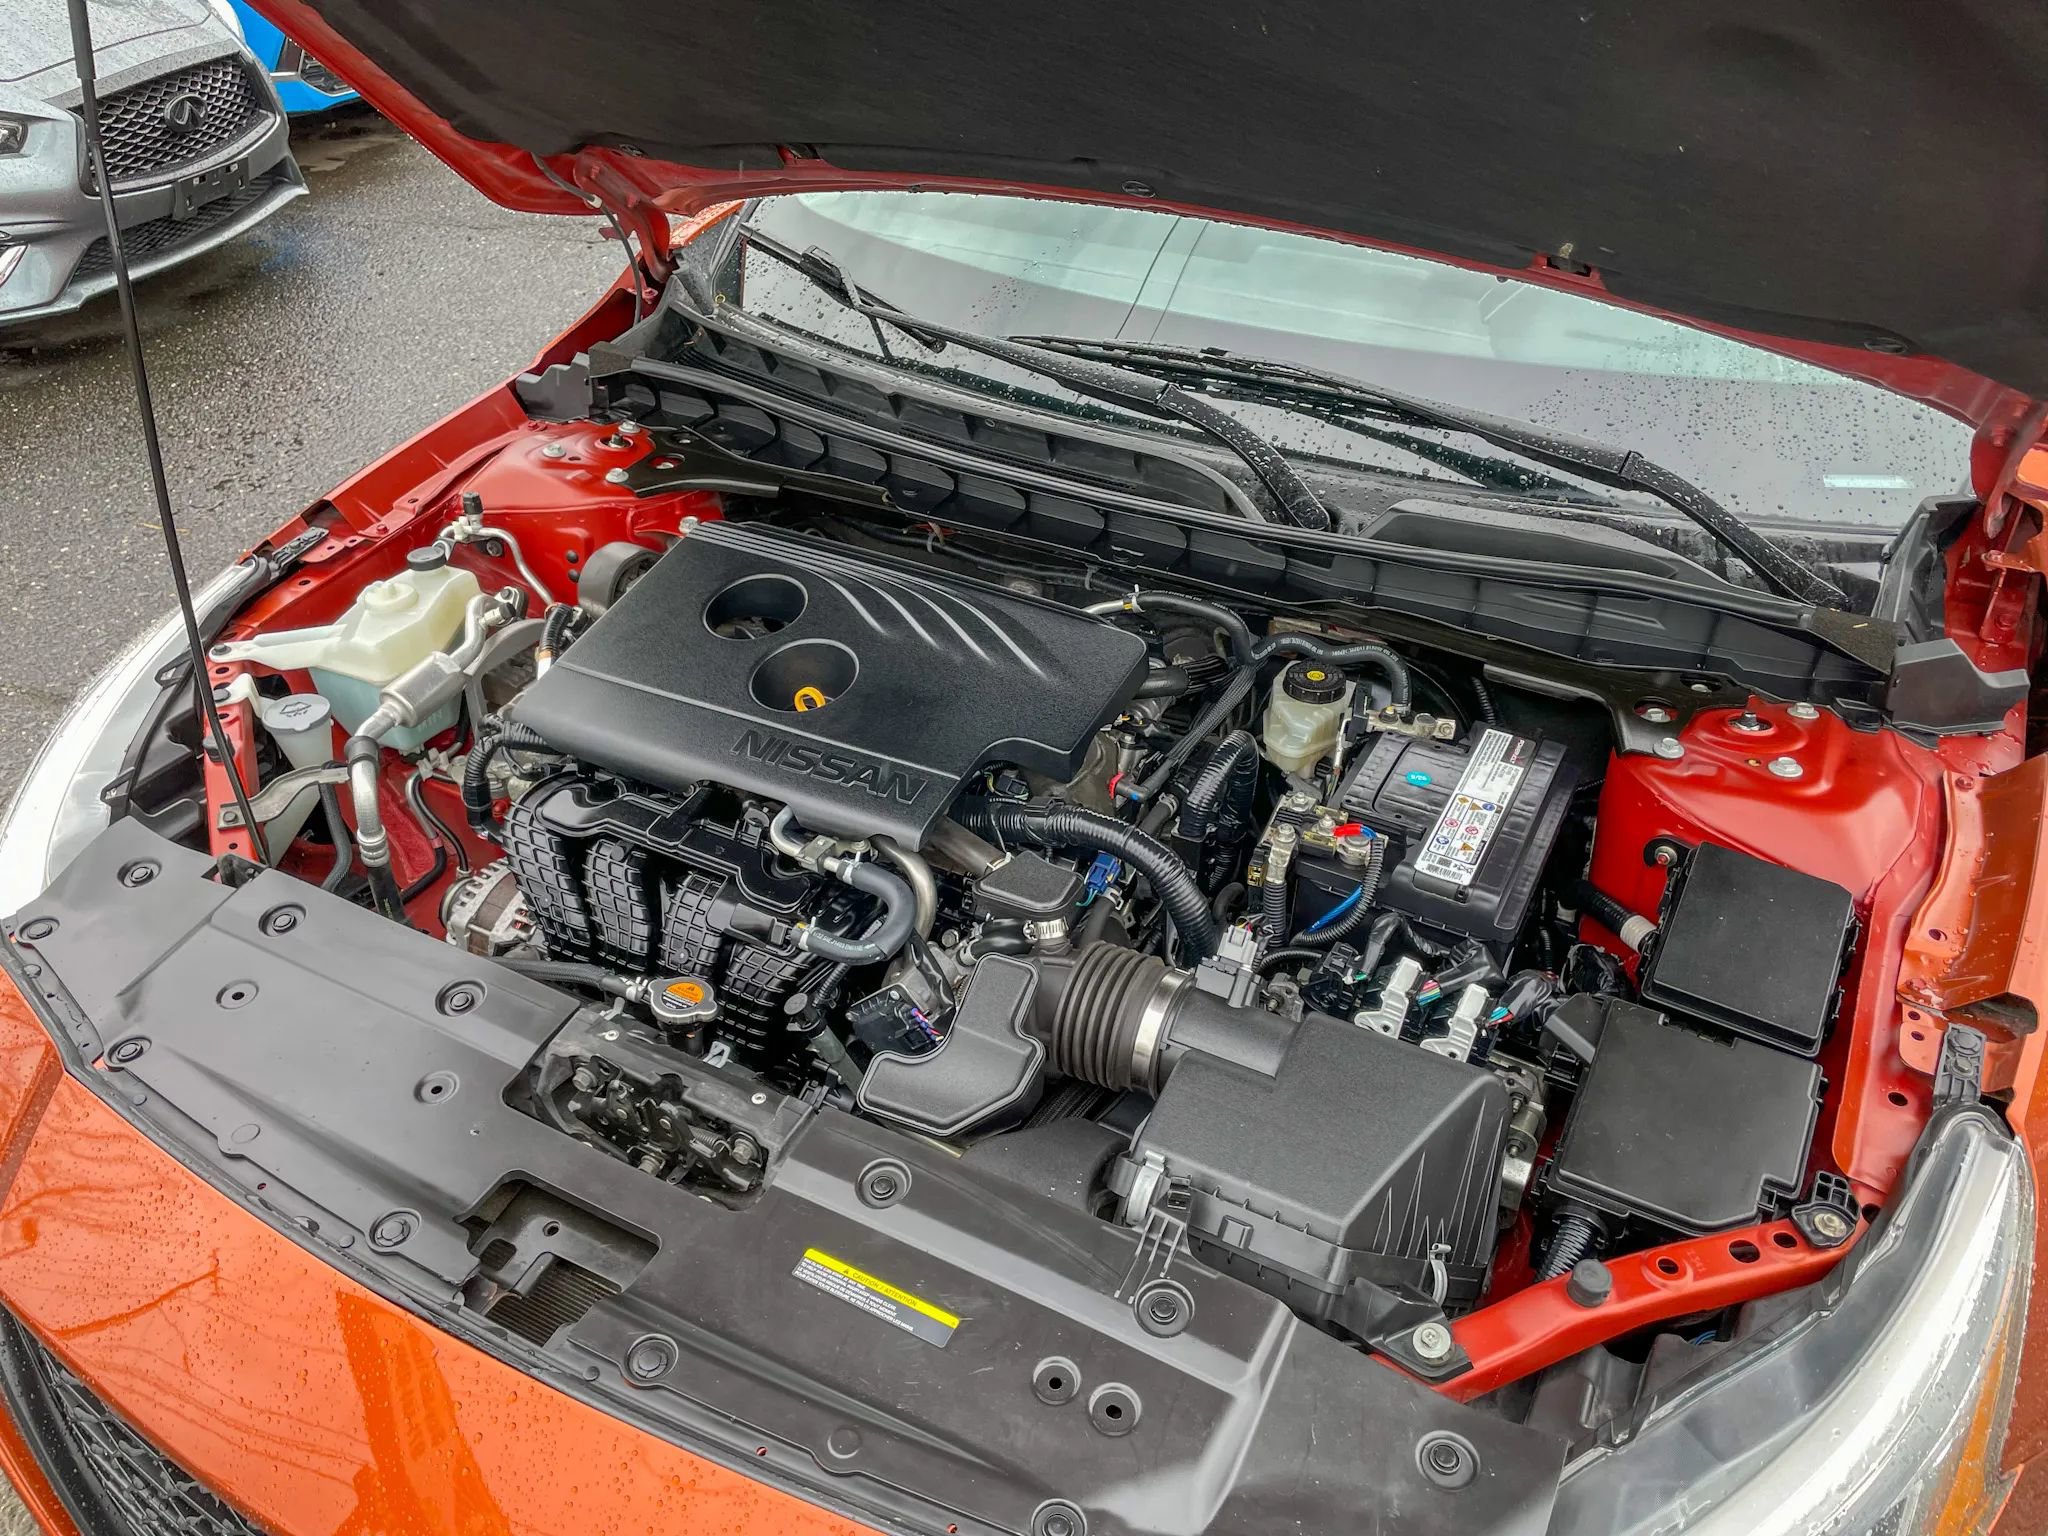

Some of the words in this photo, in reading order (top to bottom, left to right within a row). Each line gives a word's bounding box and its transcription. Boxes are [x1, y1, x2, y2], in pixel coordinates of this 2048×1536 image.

[730, 729, 928, 805] NISSAN
[853, 1272, 879, 1288] CAUTION
[884, 1287, 918, 1306] ATTENTION
